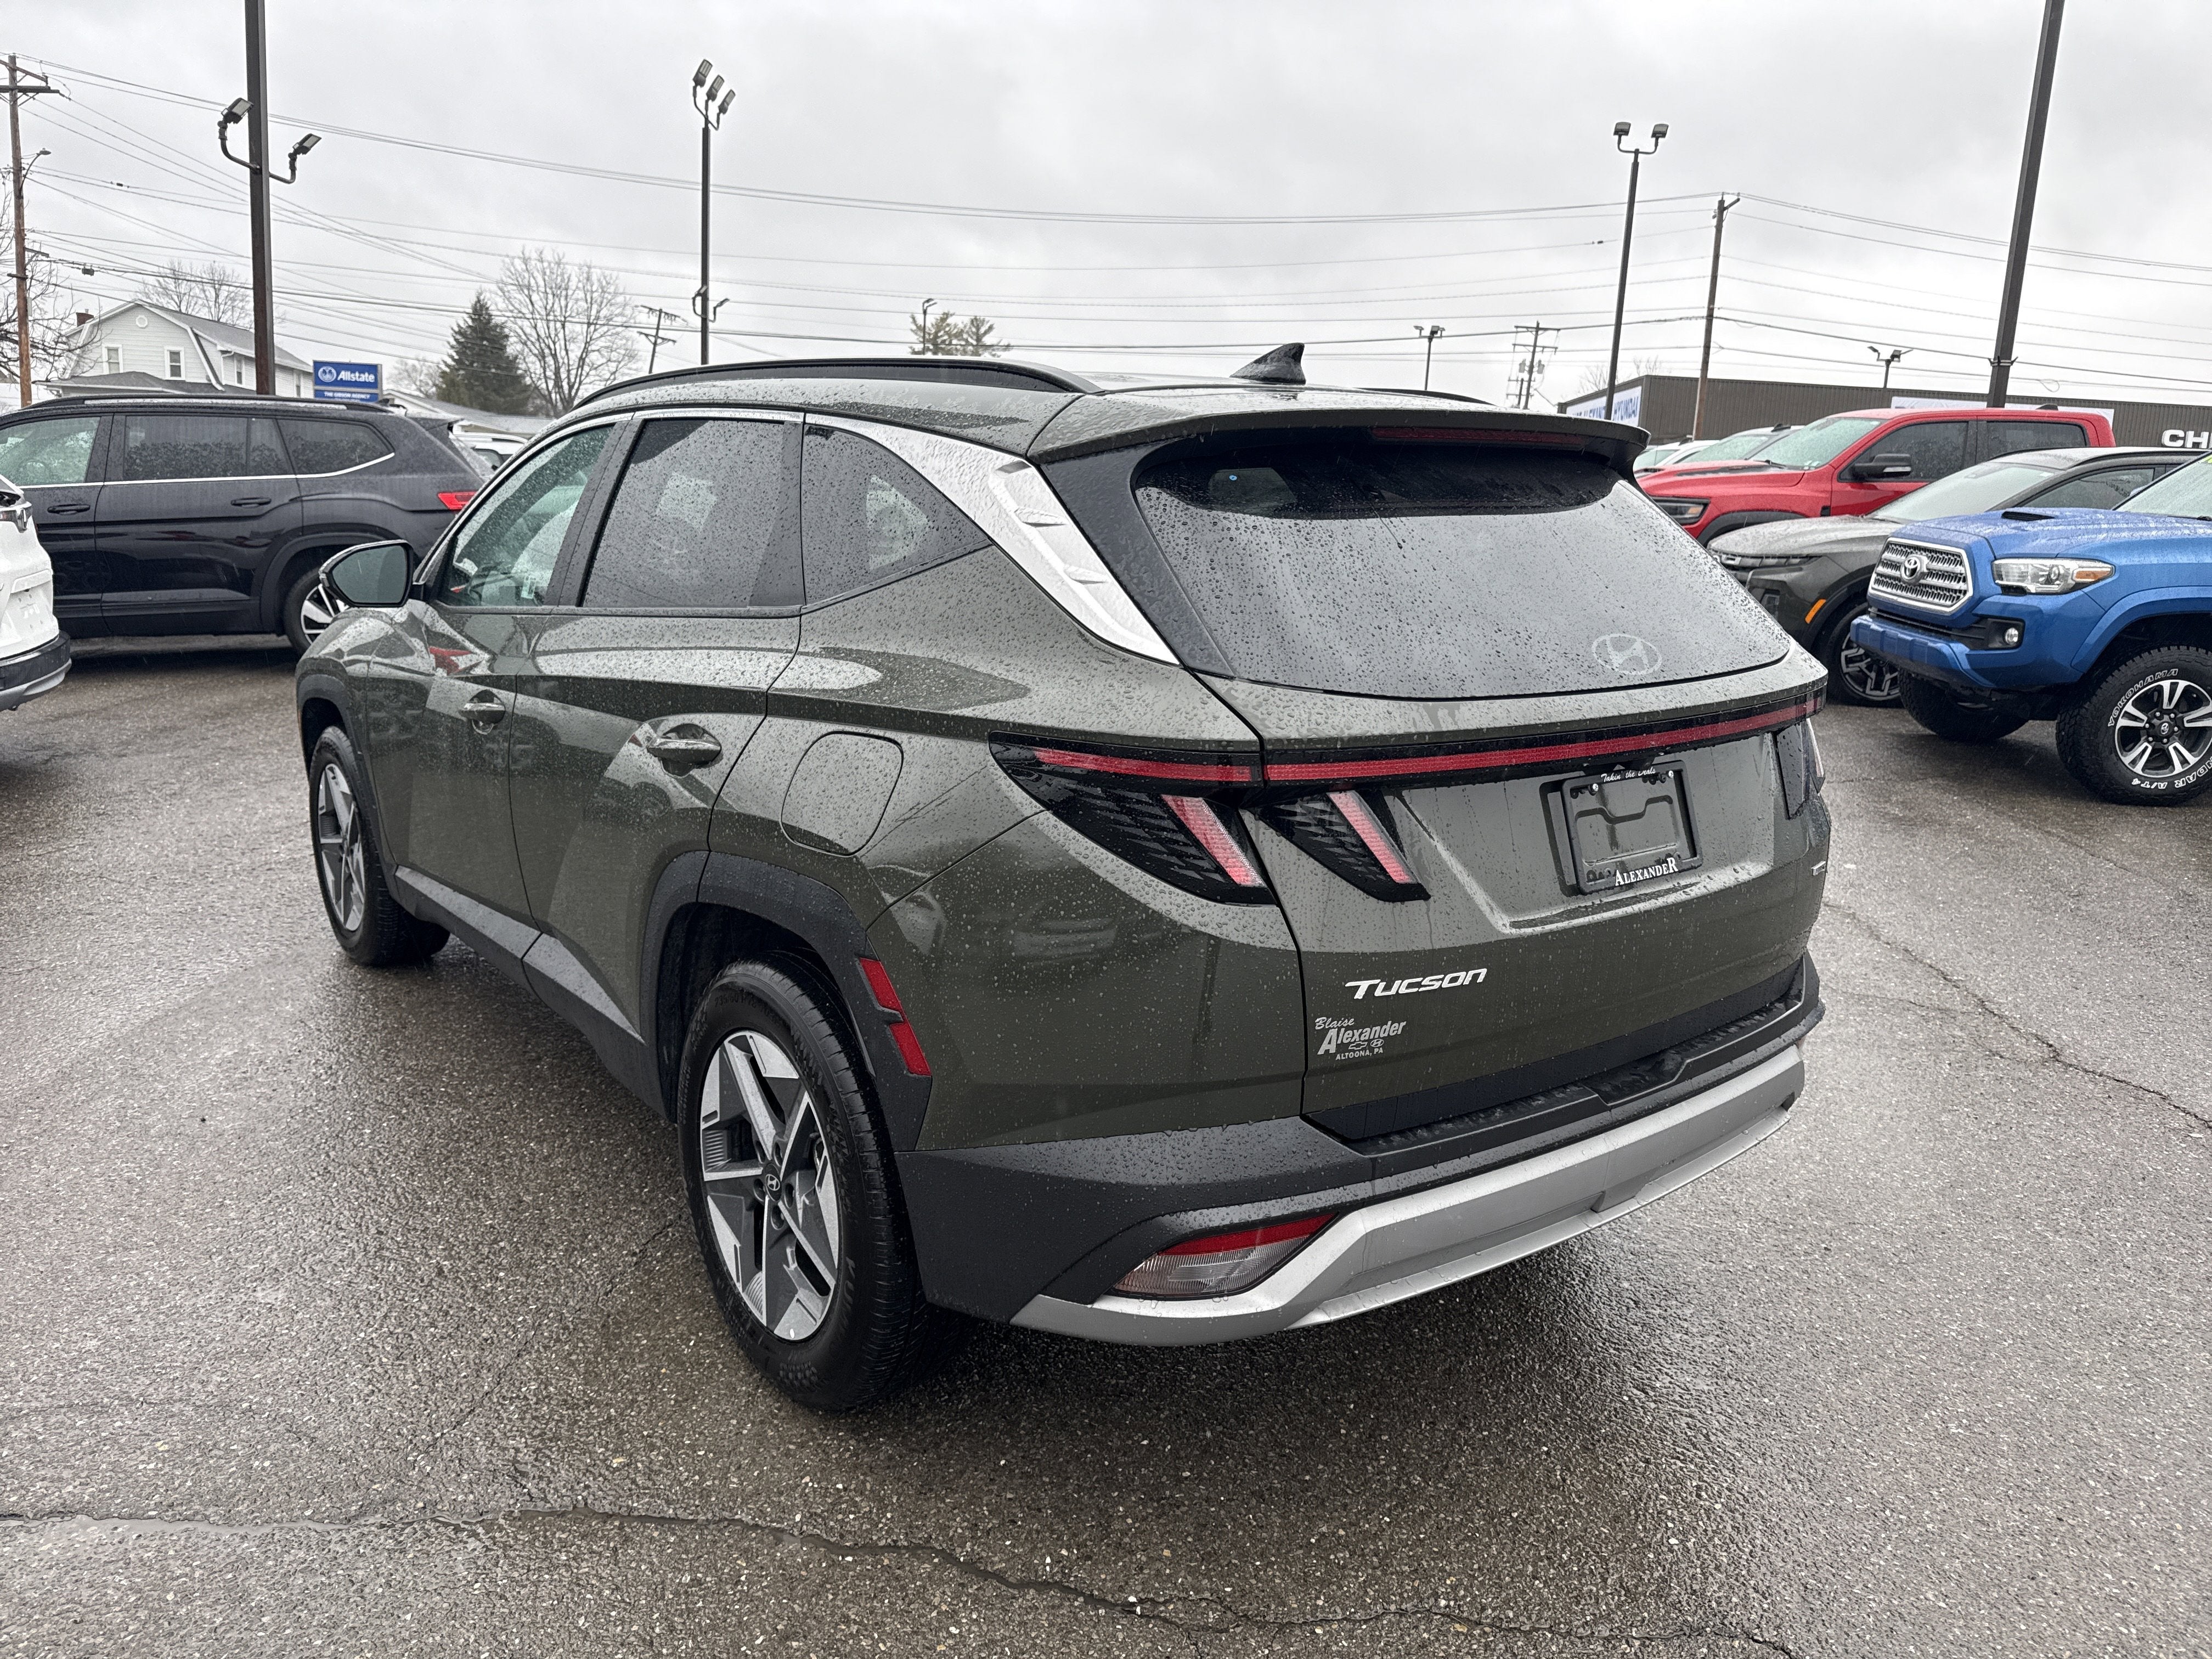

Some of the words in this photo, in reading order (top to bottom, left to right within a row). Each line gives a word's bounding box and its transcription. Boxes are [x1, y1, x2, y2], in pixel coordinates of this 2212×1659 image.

[337, 370, 375, 383] Allstate
[2162, 429, 2212, 450] CH
[2108, 668, 2178, 727] YOKOHAMA
[1615, 857, 1678, 886] ALEXANDER
[1314, 1017, 1355, 1030] Blaise
[1317, 1020, 1407, 1055] Alexander
